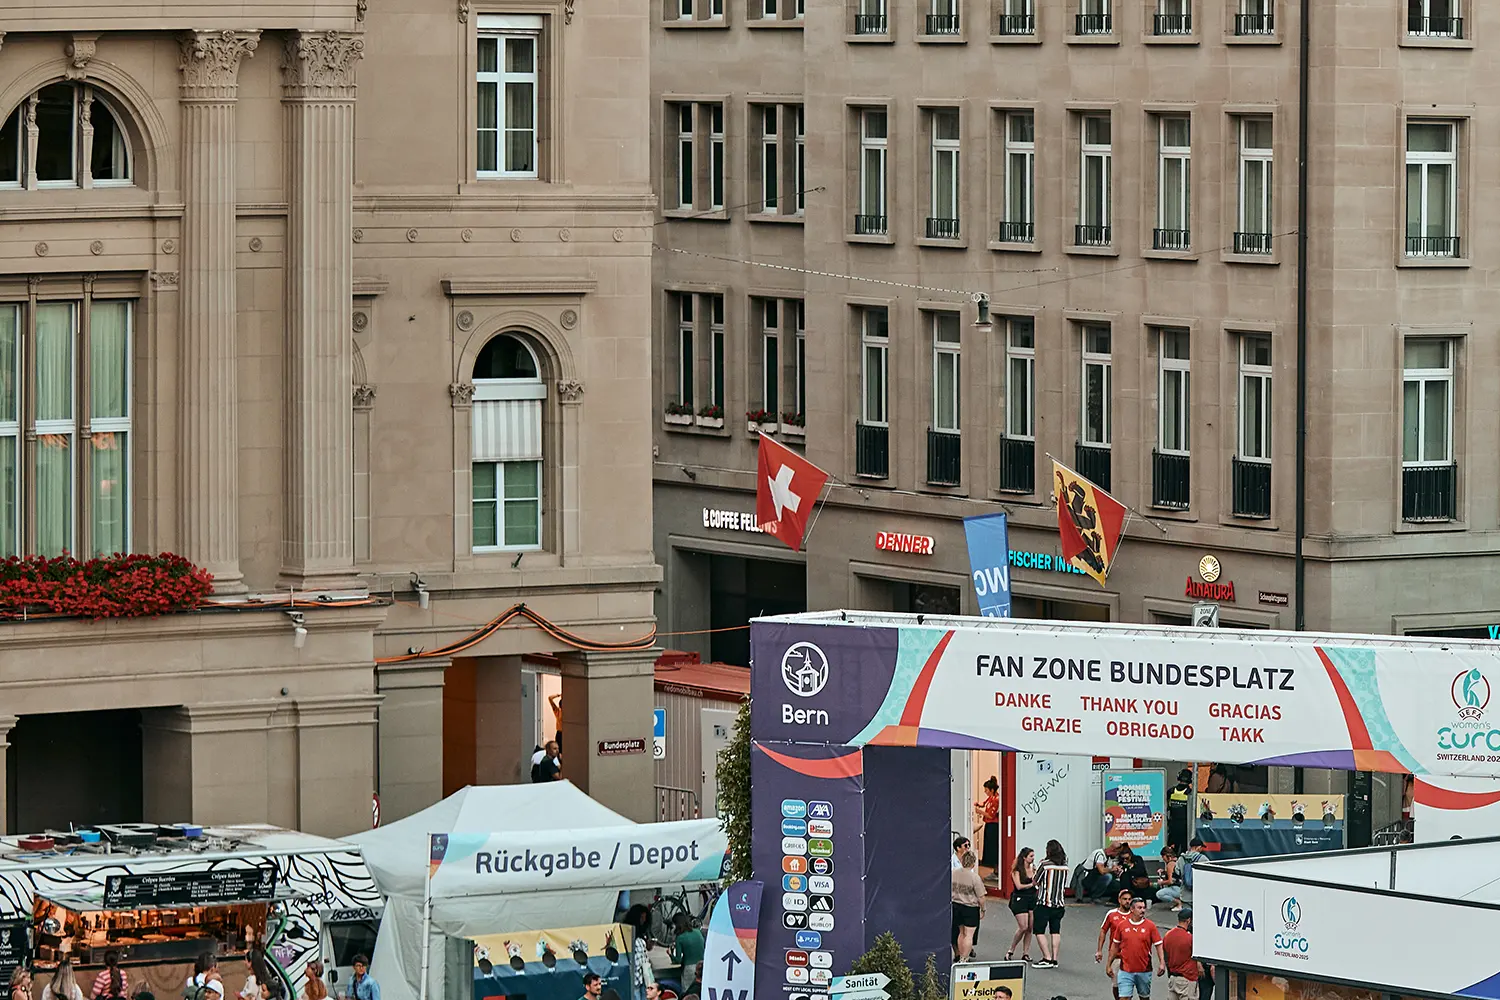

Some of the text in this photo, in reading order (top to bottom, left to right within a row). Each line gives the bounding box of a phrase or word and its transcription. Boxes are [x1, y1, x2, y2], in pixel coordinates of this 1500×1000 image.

[709, 509, 739, 529] COFFEE
[875, 531, 915, 554] DENNER
[1008, 550, 1052, 570] FISCHER
[1186, 576, 1234, 601] ALNATURA
[976, 655, 1295, 691] FAN ZONE BUNDESPLATZ
[782, 704, 830, 726] Bern
[995, 692, 1281, 720] DANKE THANK YOU GRACIAS
[1459, 708, 1482, 720] UEFA
[1022, 717, 1264, 743] GRAZIE OBRIGADO TAKK
[1451, 721, 1491, 730] women's
[604, 741, 640, 751] Bundesplatz
[1436, 753, 1485, 762] SWITZERLAND
[784, 804, 804, 812] amazon
[811, 804, 830, 816] AXA
[476, 840, 699, 877] Rückgabe / Depot
[814, 881, 830, 889] VISA
[1211, 904, 1255, 932] VISA
[845, 976, 878, 989] Sanität
